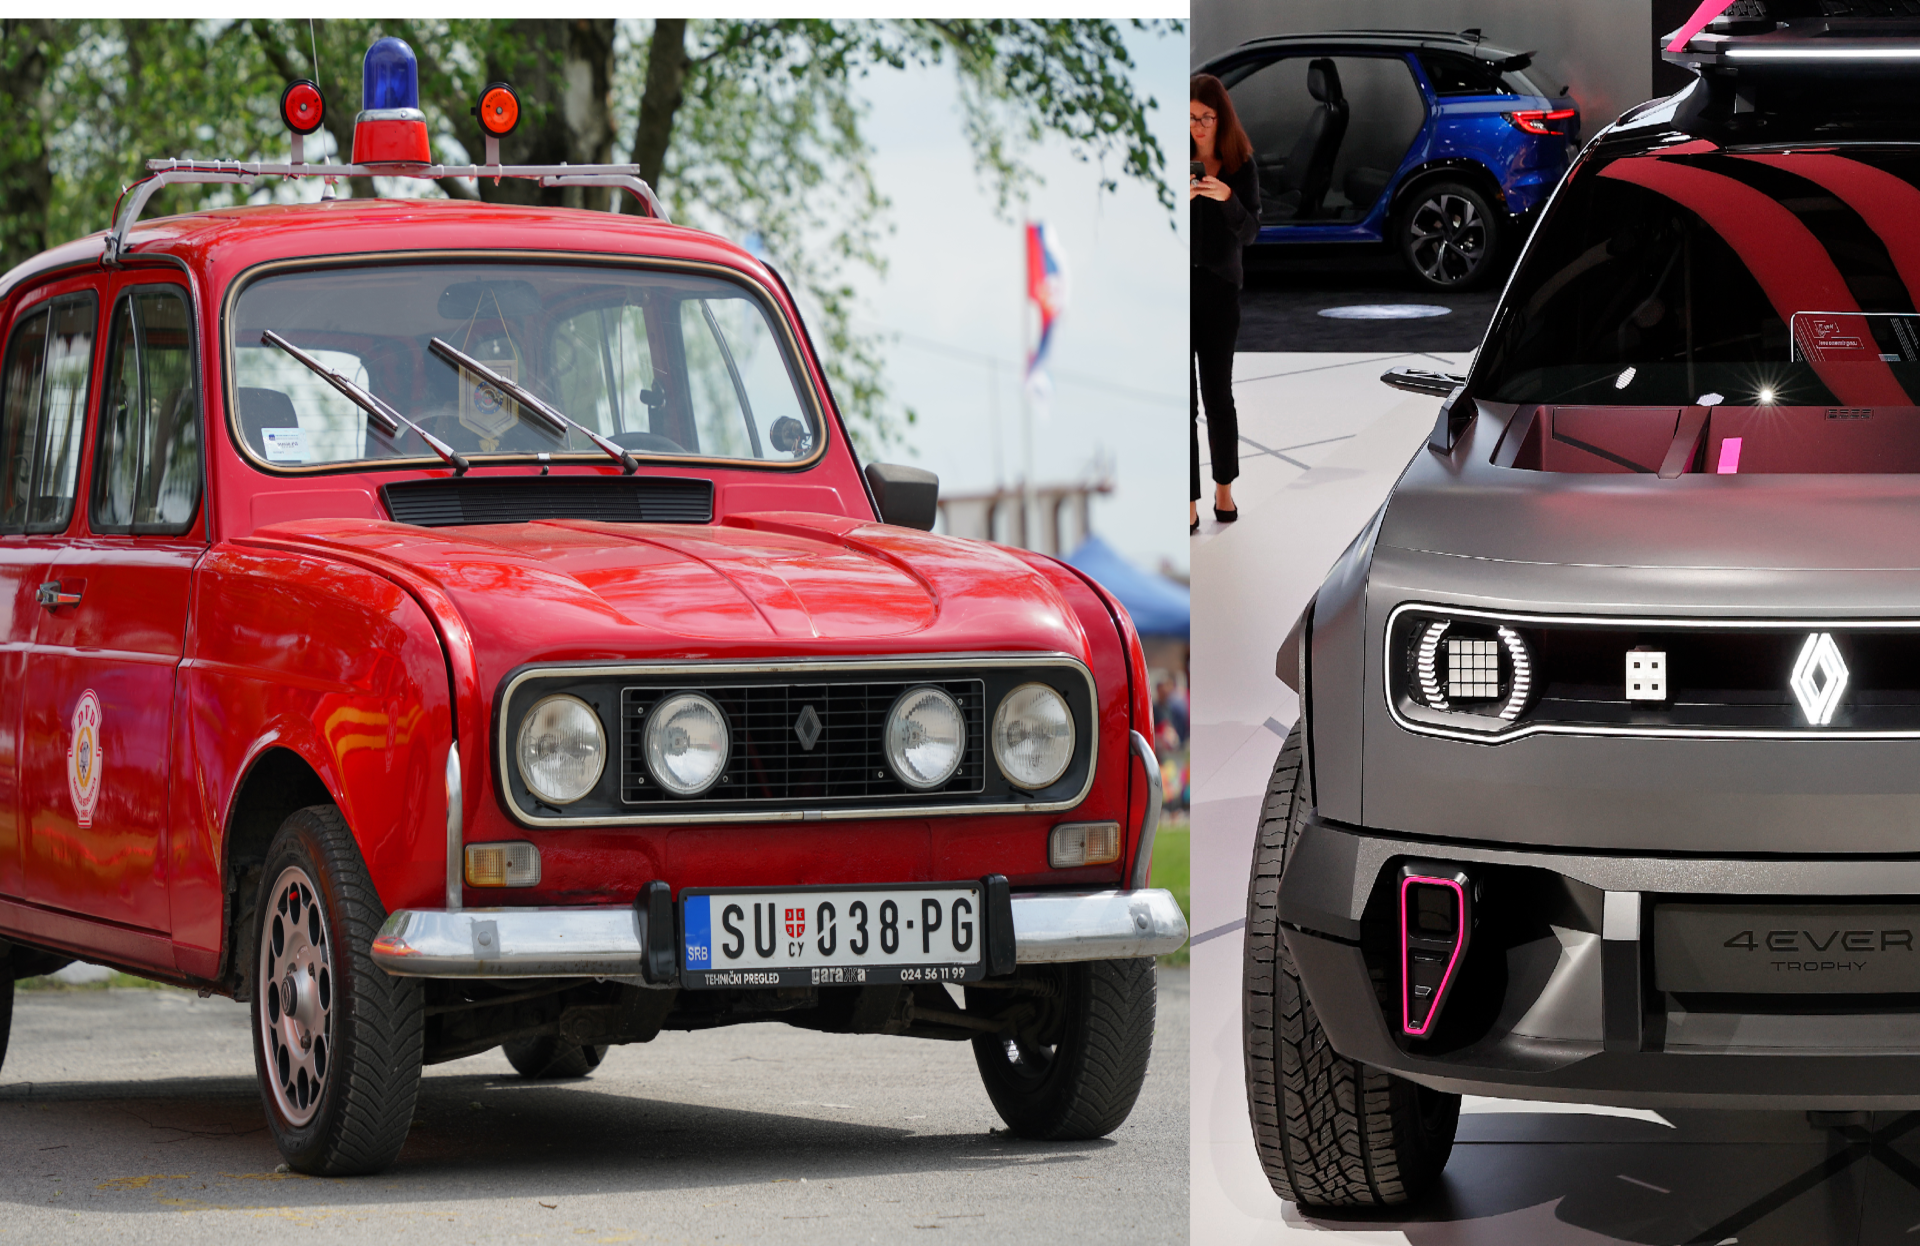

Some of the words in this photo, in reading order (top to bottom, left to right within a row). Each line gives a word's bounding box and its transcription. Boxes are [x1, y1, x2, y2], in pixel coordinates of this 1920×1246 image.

[722, 902, 777, 960] SU
[1723, 929, 1914, 952] 4EVER
[687, 946, 708, 962] SRB
[900, 967, 922, 982] 024
[924, 967, 938, 980] 56
[940, 967, 949, 979] 11
[951, 966, 966, 979] 99
[1770, 961, 1867, 972] TROPHY
[743, 972, 780, 985] PREGLED
